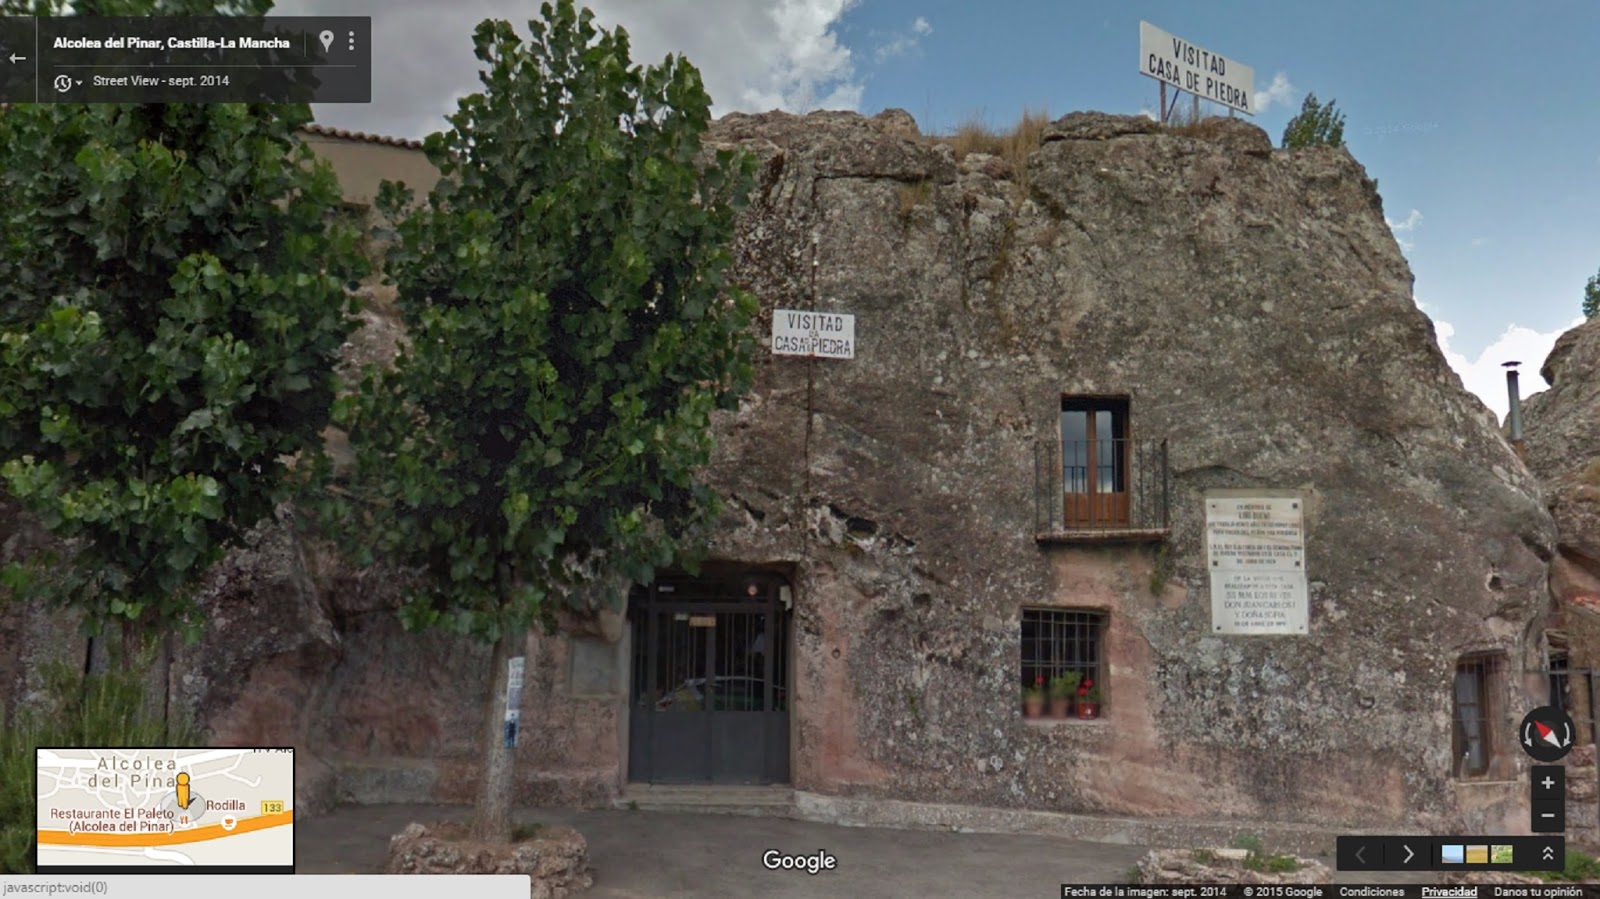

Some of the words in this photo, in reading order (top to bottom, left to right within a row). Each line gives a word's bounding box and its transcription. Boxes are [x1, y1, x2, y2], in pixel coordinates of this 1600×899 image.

[1172, 37, 1226, 76] VISITAD
[1148, 53, 1181, 86] CASA
[1186, 70, 1200, 92] DE
[1206, 77, 1249, 110] PIEDRA
[787, 313, 843, 332] VISITAD
[775, 335, 805, 352] CASA
[811, 338, 851, 355] PIEDRA
